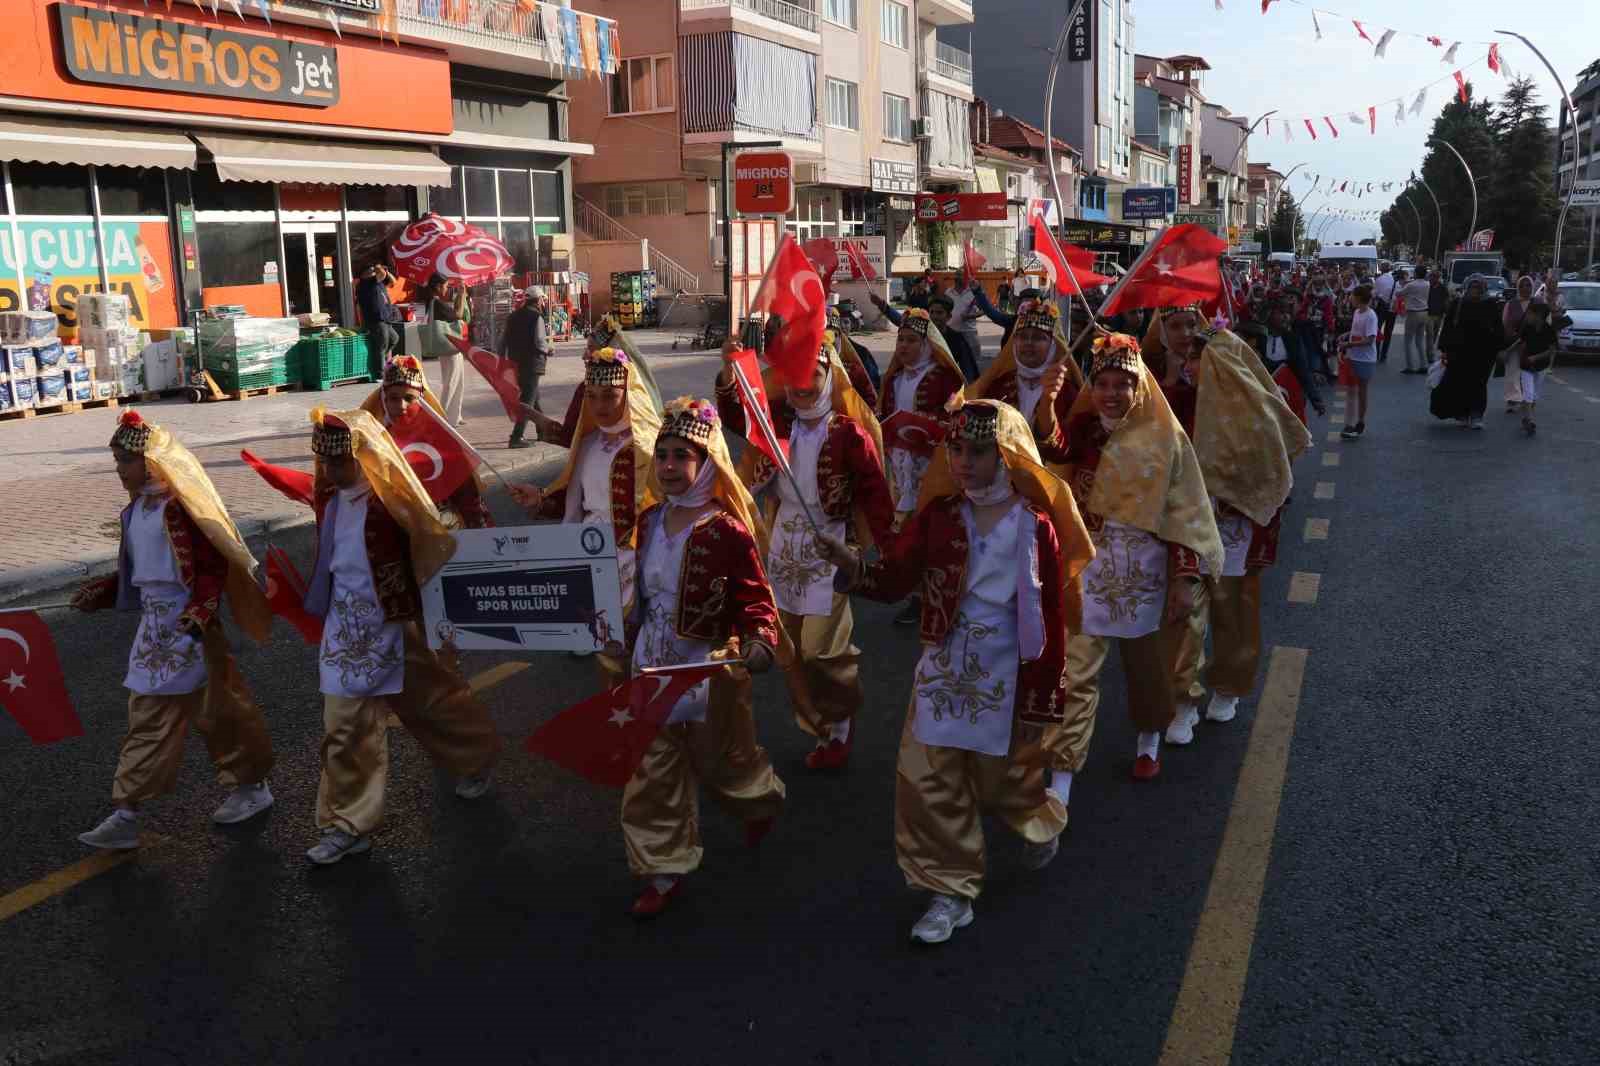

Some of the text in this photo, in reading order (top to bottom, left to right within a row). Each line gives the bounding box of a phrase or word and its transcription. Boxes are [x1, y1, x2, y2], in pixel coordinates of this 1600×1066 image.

[1075, 2, 1085, 57] APART
[290, 51, 333, 96] jet
[751, 180, 774, 199] jet
[467, 582, 568, 598] TAVAS BELEDİYE
[477, 596, 560, 611] SPOR KULÜBÜ
